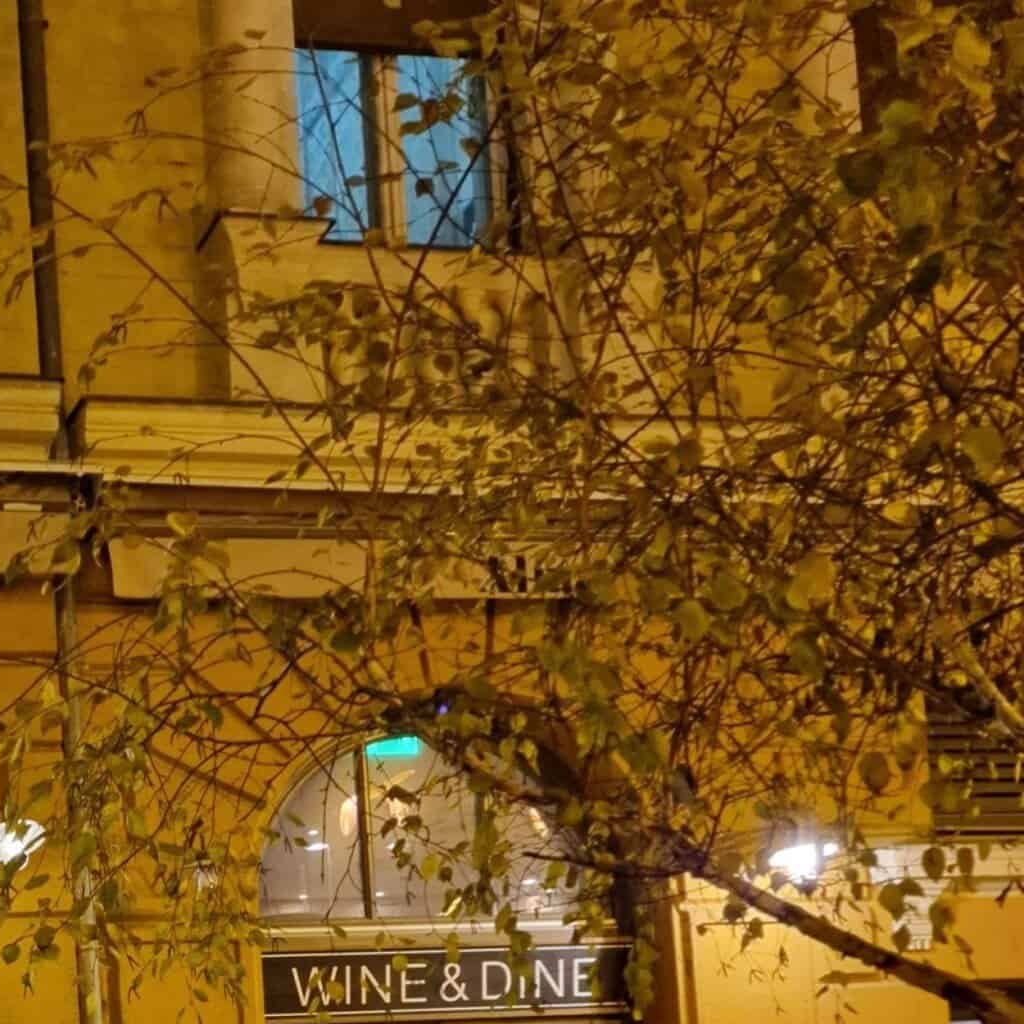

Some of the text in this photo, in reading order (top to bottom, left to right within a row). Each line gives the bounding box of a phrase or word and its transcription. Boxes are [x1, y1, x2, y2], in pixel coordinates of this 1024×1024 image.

[291, 956, 599, 1007] WINE & DINE
